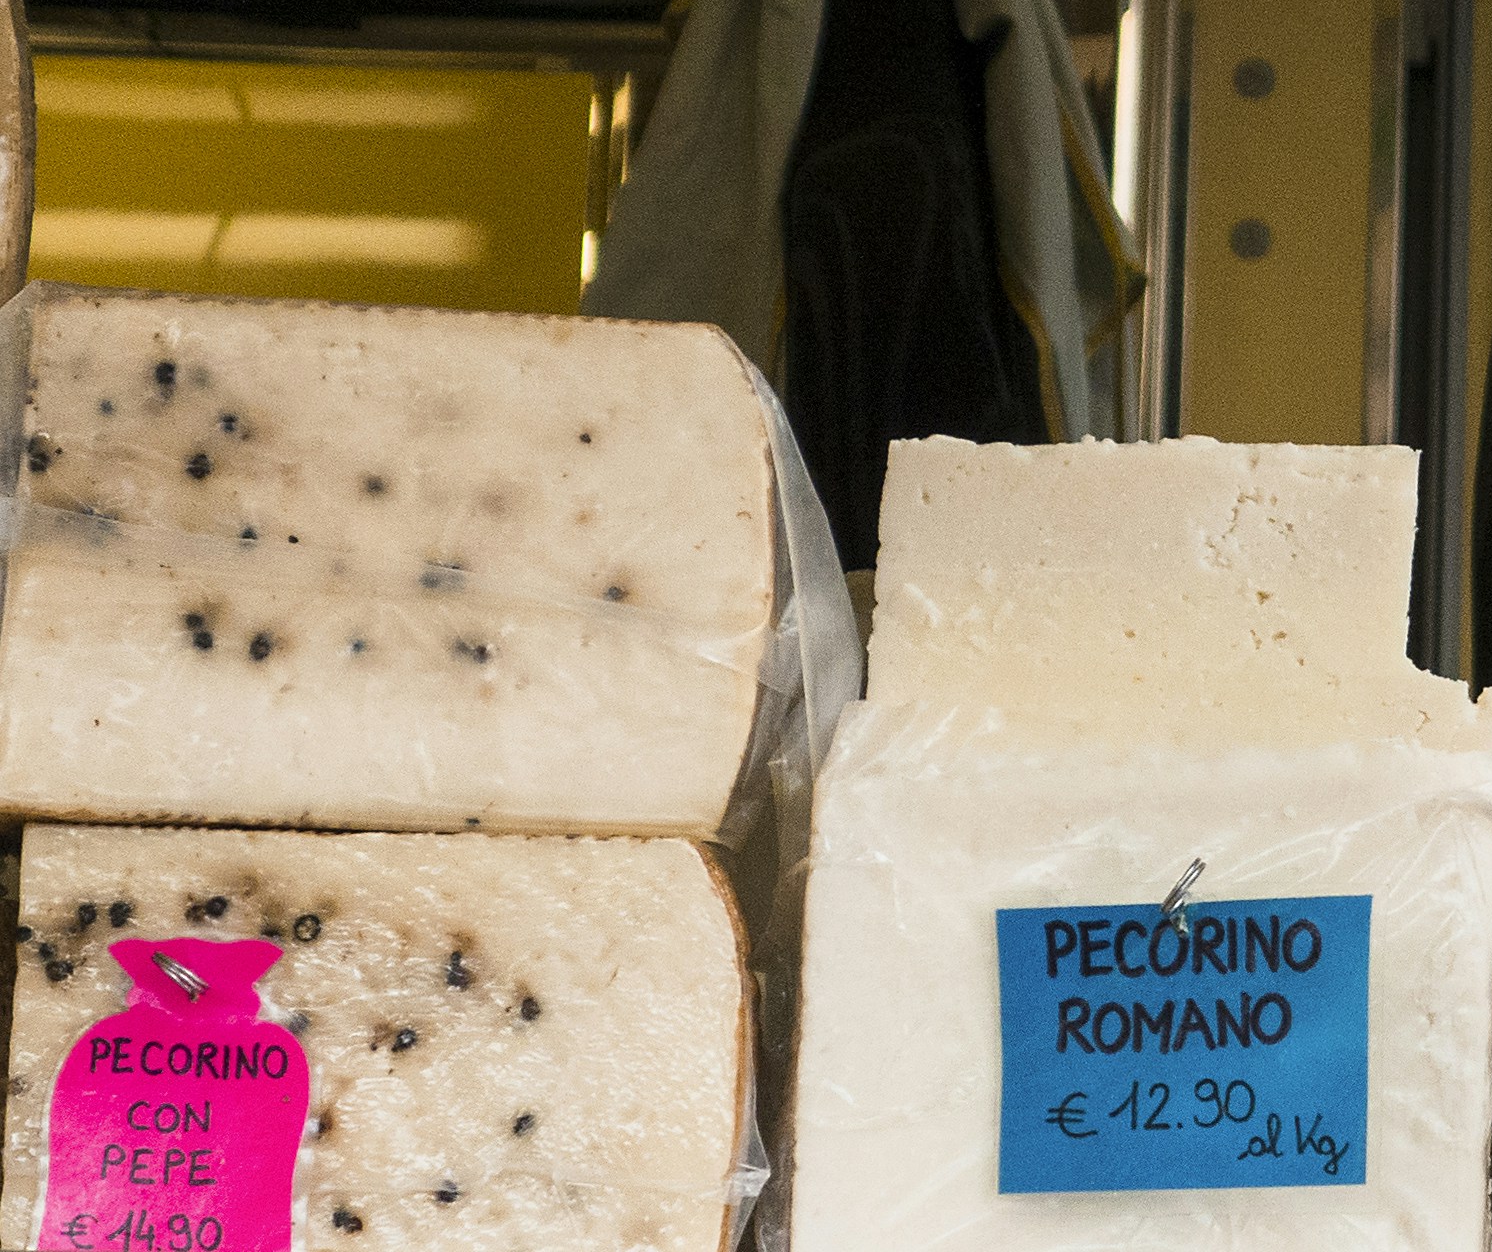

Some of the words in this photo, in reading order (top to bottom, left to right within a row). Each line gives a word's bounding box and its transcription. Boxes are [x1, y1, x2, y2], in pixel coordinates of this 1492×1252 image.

[1045, 915, 1321, 978] PECORINO
[1056, 992, 1292, 1054] ROMANO
[90, 1037, 288, 1079] PECORINO
[128, 1101, 210, 1133] CON
[1045, 1092, 1097, 1139] €
[1109, 1078, 1255, 1130] 12.90
[1238, 1112, 1283, 1159] al
[1295, 1112, 1349, 1175] Kg
[100, 1144, 217, 1186] PEPE
[61, 1213, 98, 1249] €
[107, 1210, 223, 1252] 14.90
